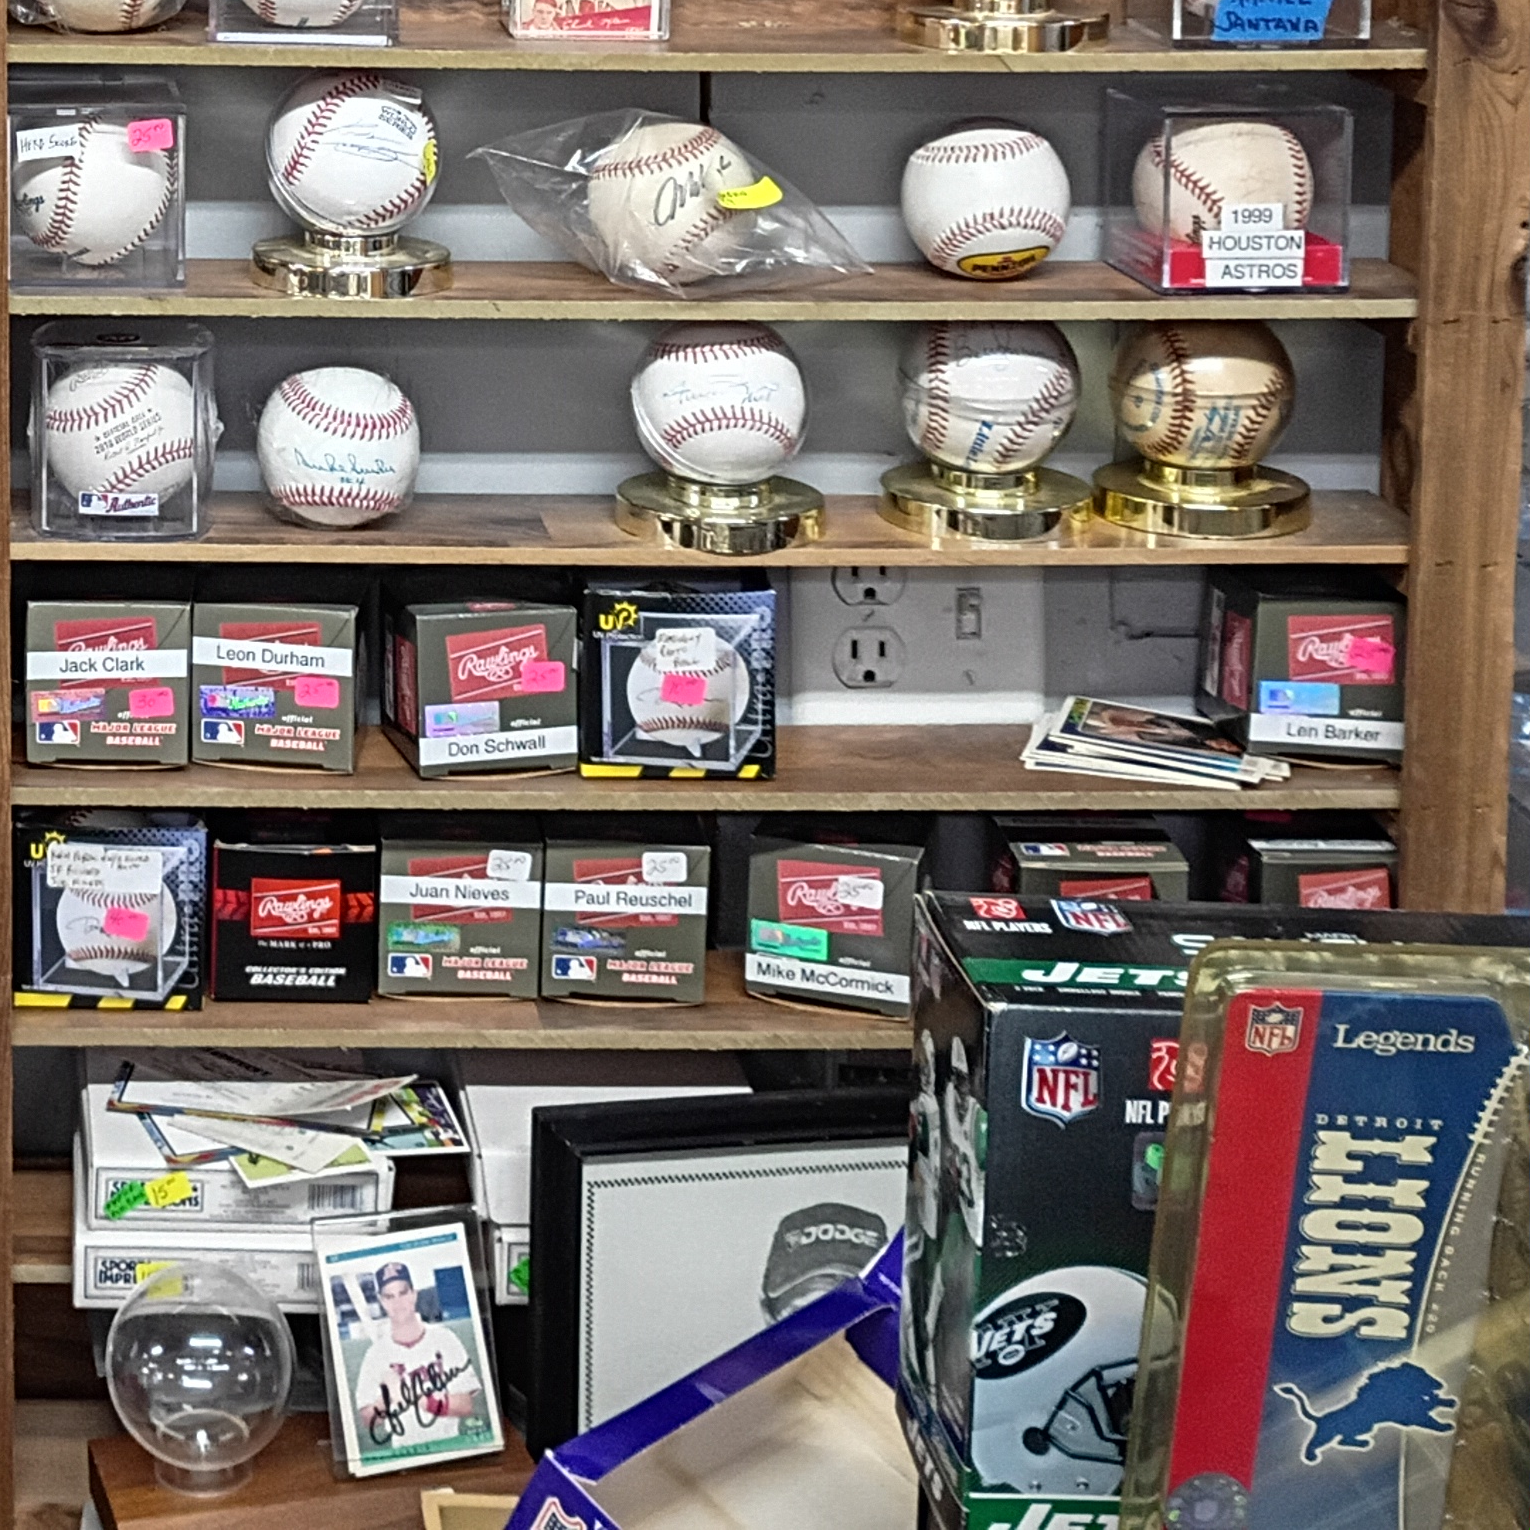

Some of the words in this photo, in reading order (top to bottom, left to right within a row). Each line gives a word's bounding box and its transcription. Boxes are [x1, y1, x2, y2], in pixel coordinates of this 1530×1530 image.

[1230, 208, 1273, 225] 1999
[1208, 235, 1303, 251] HOUSTON
[1220, 263, 1299, 280] ASTROS
[216, 643, 256, 663] Leon
[261, 648, 326, 668] Durham
[458, 645, 540, 681] Rawlings
[59, 657, 98, 673] Jack
[102, 657, 146, 672] Clark
[90, 722, 130, 734] MAJOR
[132, 723, 177, 735] LEAGUE
[255, 723, 294, 737] MAJOR
[296, 726, 341, 740] LEAGUE
[1286, 723, 1320, 739] Len
[1324, 726, 1382, 743] Barker
[105, 735, 162, 747] BASEBALL
[269, 738, 325, 751] BASEBALL
[447, 741, 480, 757] Don
[483, 735, 546, 754] Schwall
[409, 884, 450, 900] Juan
[454, 884, 510, 901] Nieves
[573, 890, 610, 906] Paul
[616, 890, 693, 908] Reuschel
[257, 893, 334, 924] Rawlings
[963, 918, 991, 932] NFL
[993, 920, 1053, 935] PLAYERS
[1070, 912, 1128, 930] NFL
[250, 973, 337, 988] BASEBALL
[456, 970, 513, 981] BASEBALL
[621, 973, 678, 985] BASEBALL
[757, 962, 797, 983] Mike
[799, 968, 895, 996] McCormick
[1249, 1024, 1296, 1049] NFL
[1331, 1023, 1477, 1057] Legends
[1034, 1065, 1099, 1113] NFL
[1315, 1113, 1445, 1130] DETROIT
[1286, 1129, 1438, 1341] LIONS
